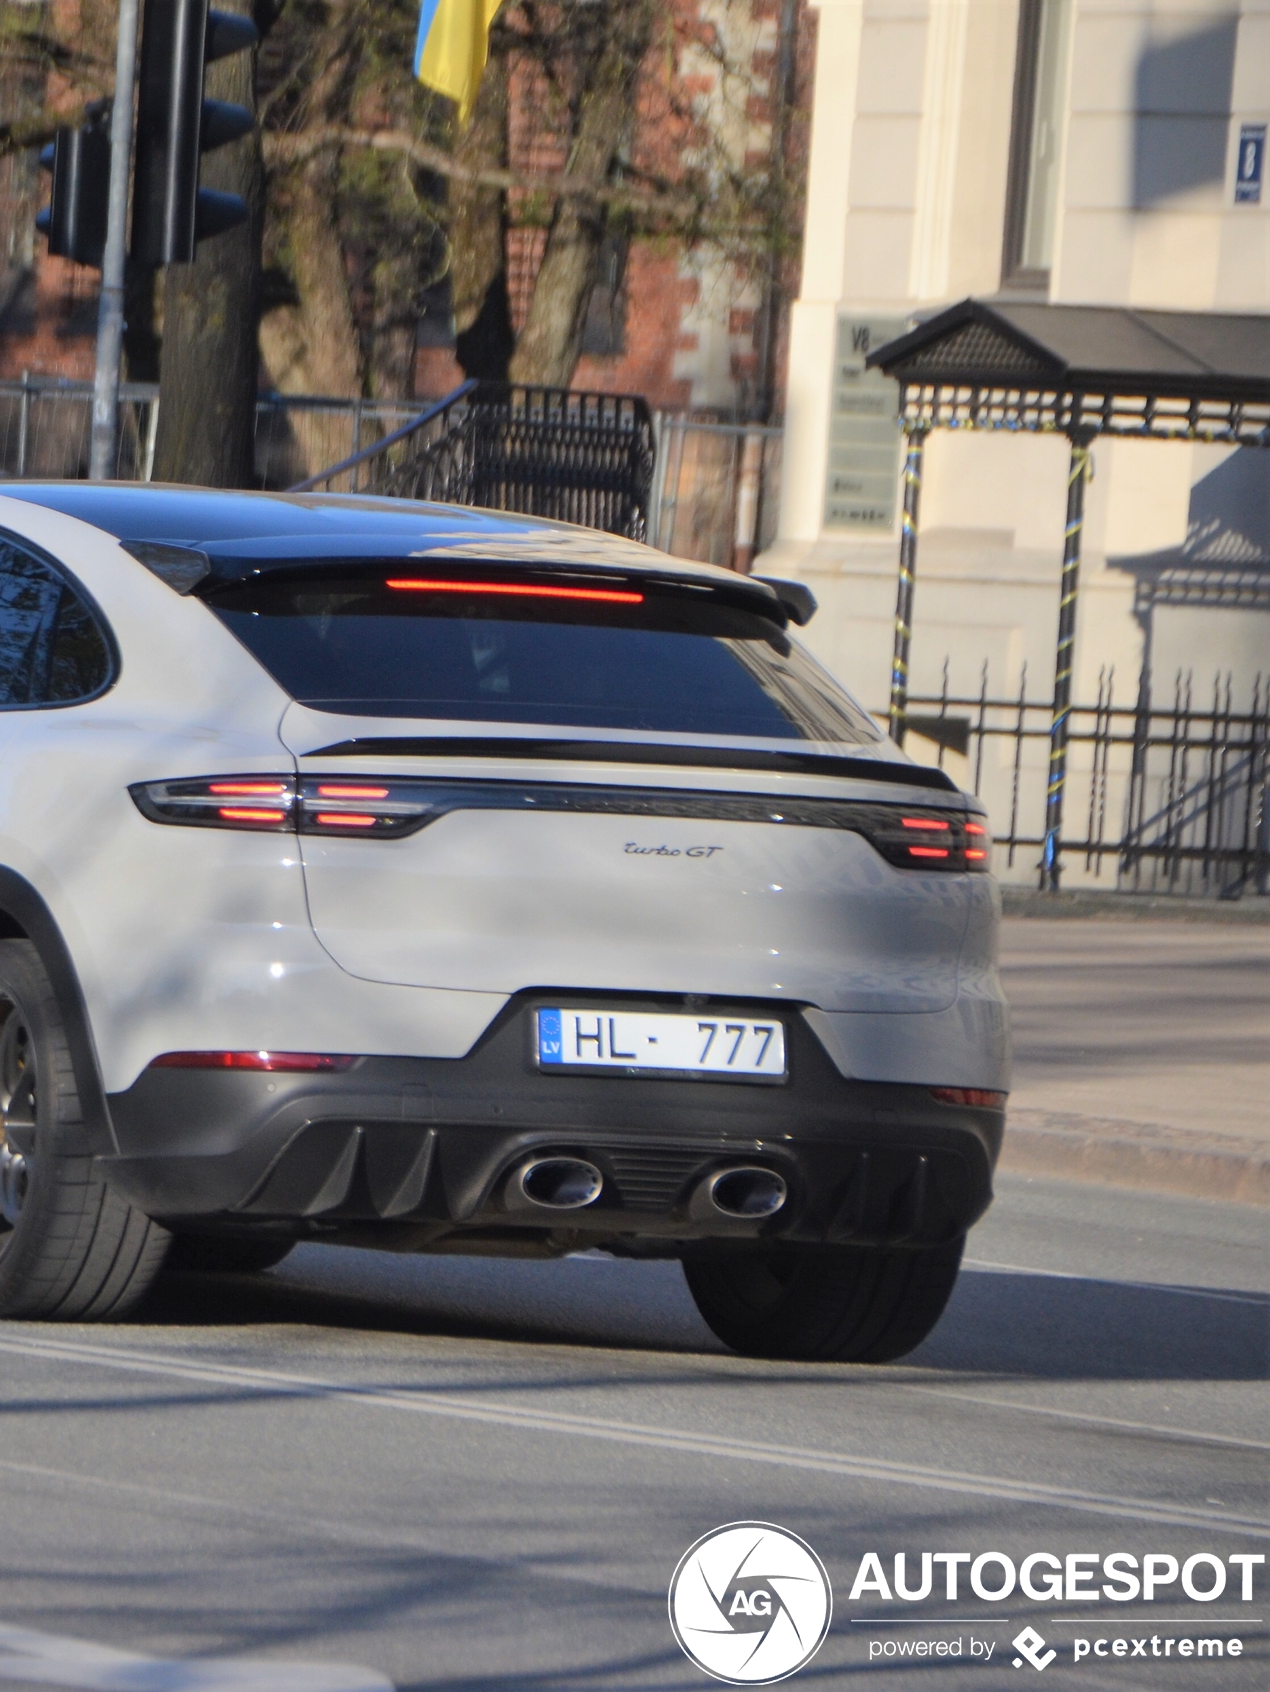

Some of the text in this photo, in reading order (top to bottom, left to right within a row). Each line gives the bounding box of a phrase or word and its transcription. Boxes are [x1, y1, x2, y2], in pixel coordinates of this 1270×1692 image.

[686, 846, 724, 858] GT
[542, 1041, 560, 1054] LV
[697, 1022, 775, 1067] 777
